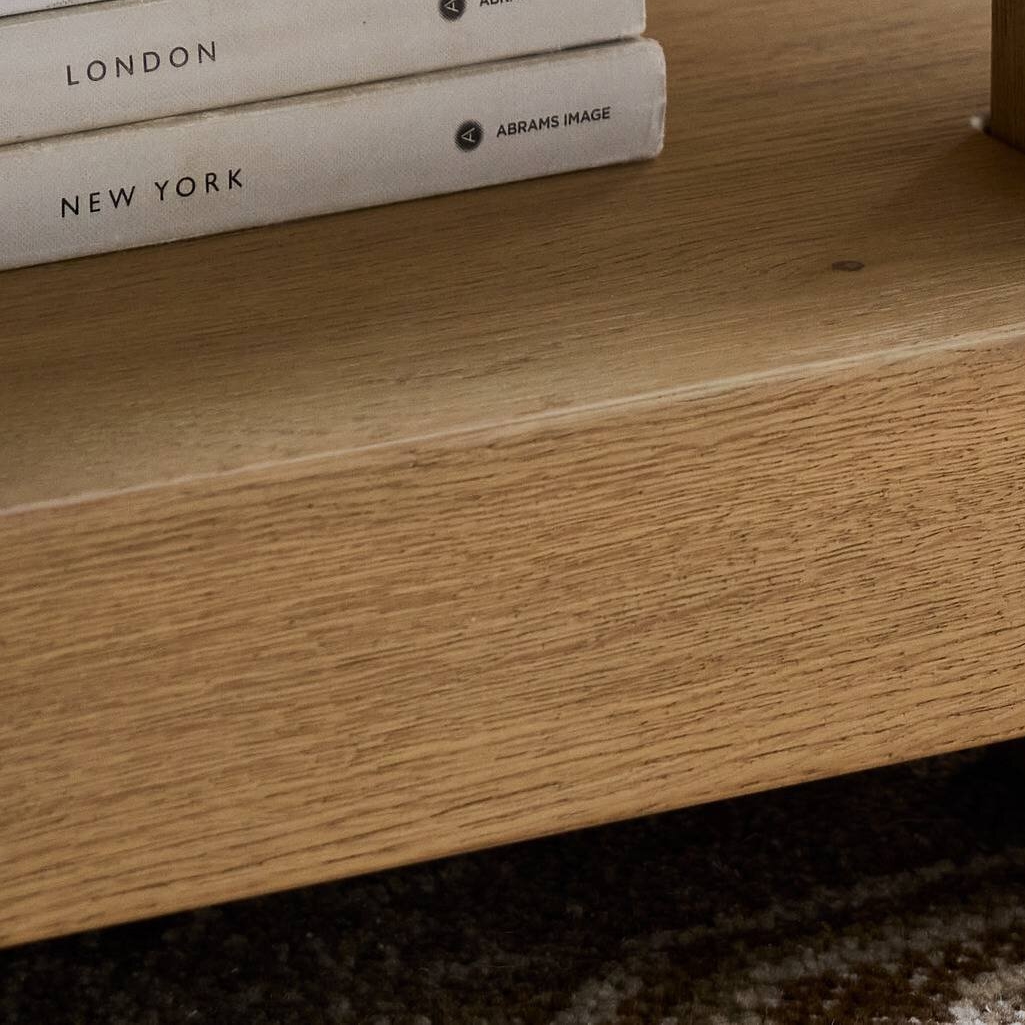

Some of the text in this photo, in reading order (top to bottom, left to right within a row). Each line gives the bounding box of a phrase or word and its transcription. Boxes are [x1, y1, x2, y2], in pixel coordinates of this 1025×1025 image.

[67, 41, 216, 86] LONDON
[497, 106, 612, 138] ABRAMS IMAGE
[62, 169, 243, 219] NEW YORK
